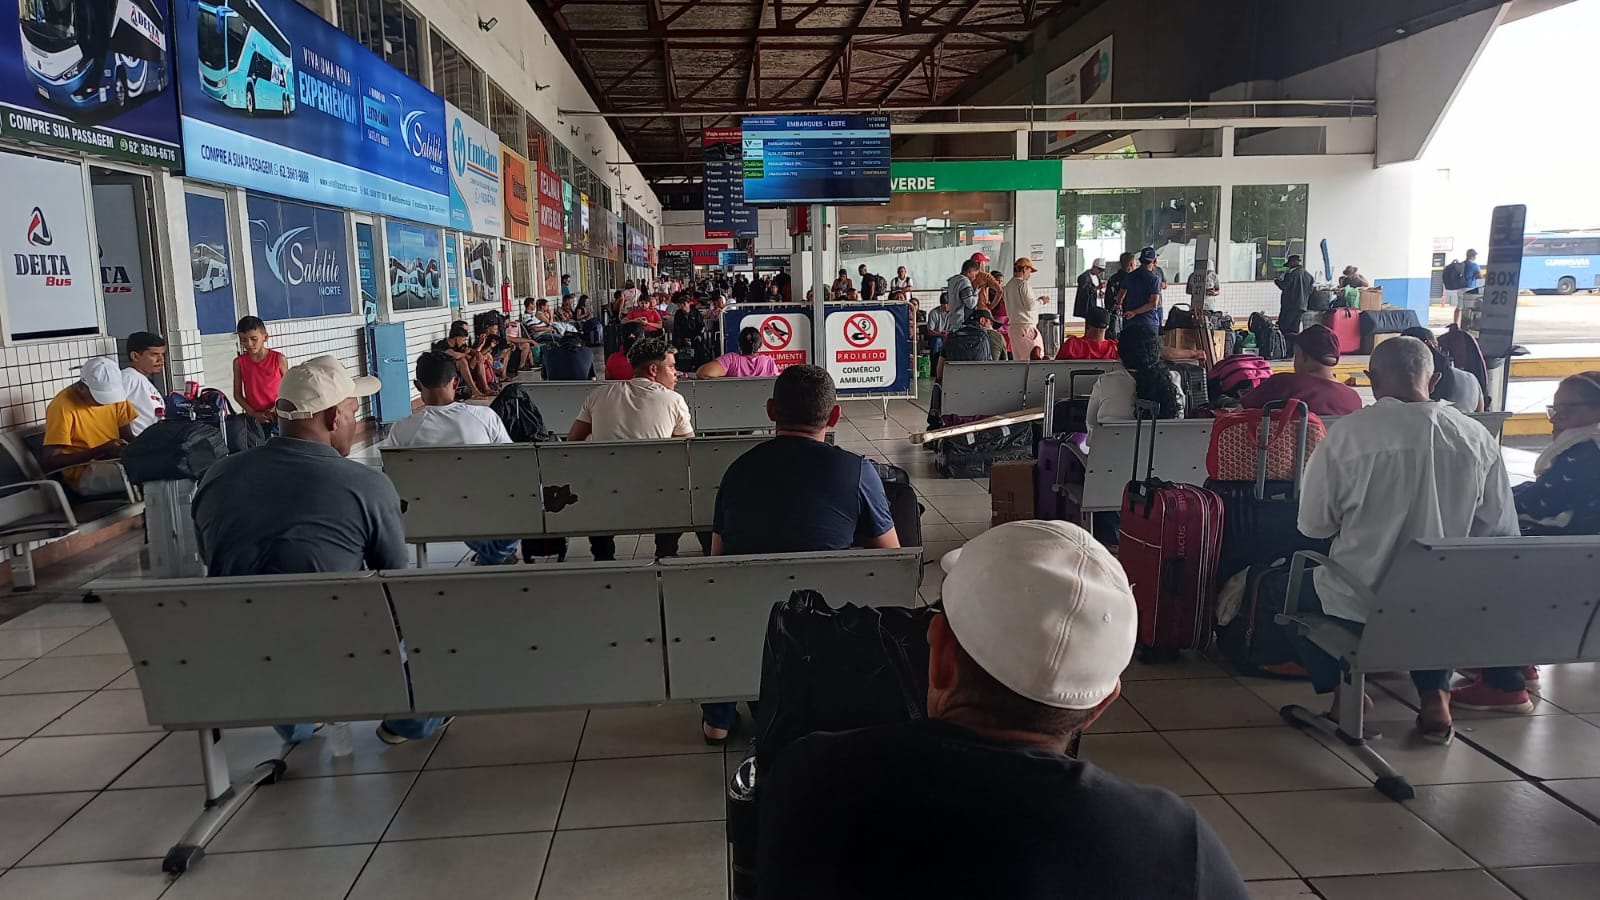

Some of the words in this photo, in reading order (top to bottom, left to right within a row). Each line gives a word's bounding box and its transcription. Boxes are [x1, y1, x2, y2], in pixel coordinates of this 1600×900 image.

[303, 47, 319, 71] VIVA
[320, 58, 335, 79] UMA
[336, 64, 351, 87] NOVA
[299, 70, 358, 126] EXPERIÊNCIA
[9, 113, 51, 135] COMPRE
[52, 123, 71, 139] SUA
[72, 127, 114, 148] PASSAGEM
[200, 144, 228, 165] COMPRE
[228, 151, 233, 166] A
[232, 152, 246, 168] SUA
[245, 156, 274, 176] PASSAGEM
[467, 136, 498, 174] Emtram
[890, 177, 935, 190] VERDE
[14, 253, 71, 275] DELTA
[46, 276, 72, 286] Bus
[1487, 272, 1517, 286] BOX
[319, 286, 341, 295] NORTE
[1490, 291, 1508, 304] 26
[837, 352, 885, 360] PROIBIDO
[842, 366, 880, 374] COMÉRCIO
[839, 376, 884, 384] AMBULANTE
